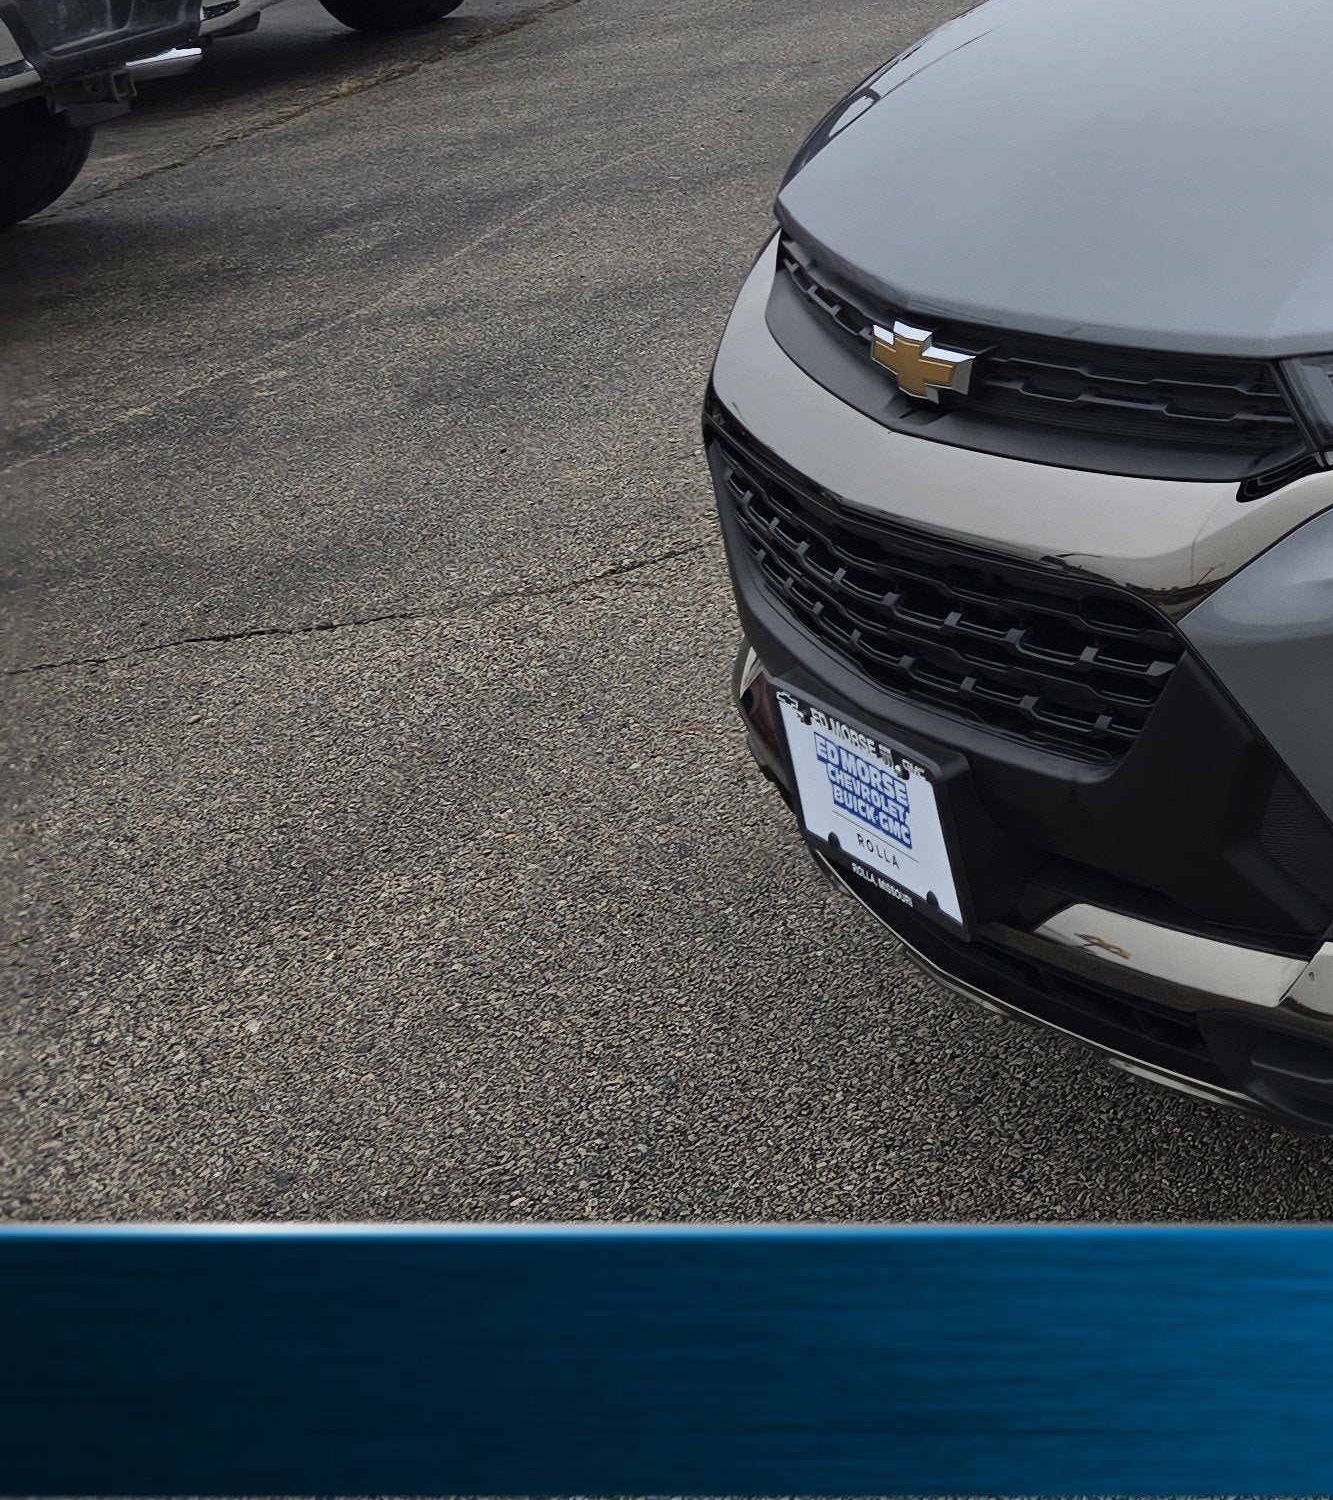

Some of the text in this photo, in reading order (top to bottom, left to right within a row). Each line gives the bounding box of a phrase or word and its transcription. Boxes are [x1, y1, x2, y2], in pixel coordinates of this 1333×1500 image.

[829, 717, 876, 755] MORSE
[815, 735, 909, 808] ED MORSE
[826, 763, 908, 824] CHEVROLET
[856, 833, 900, 870] ROLLA
